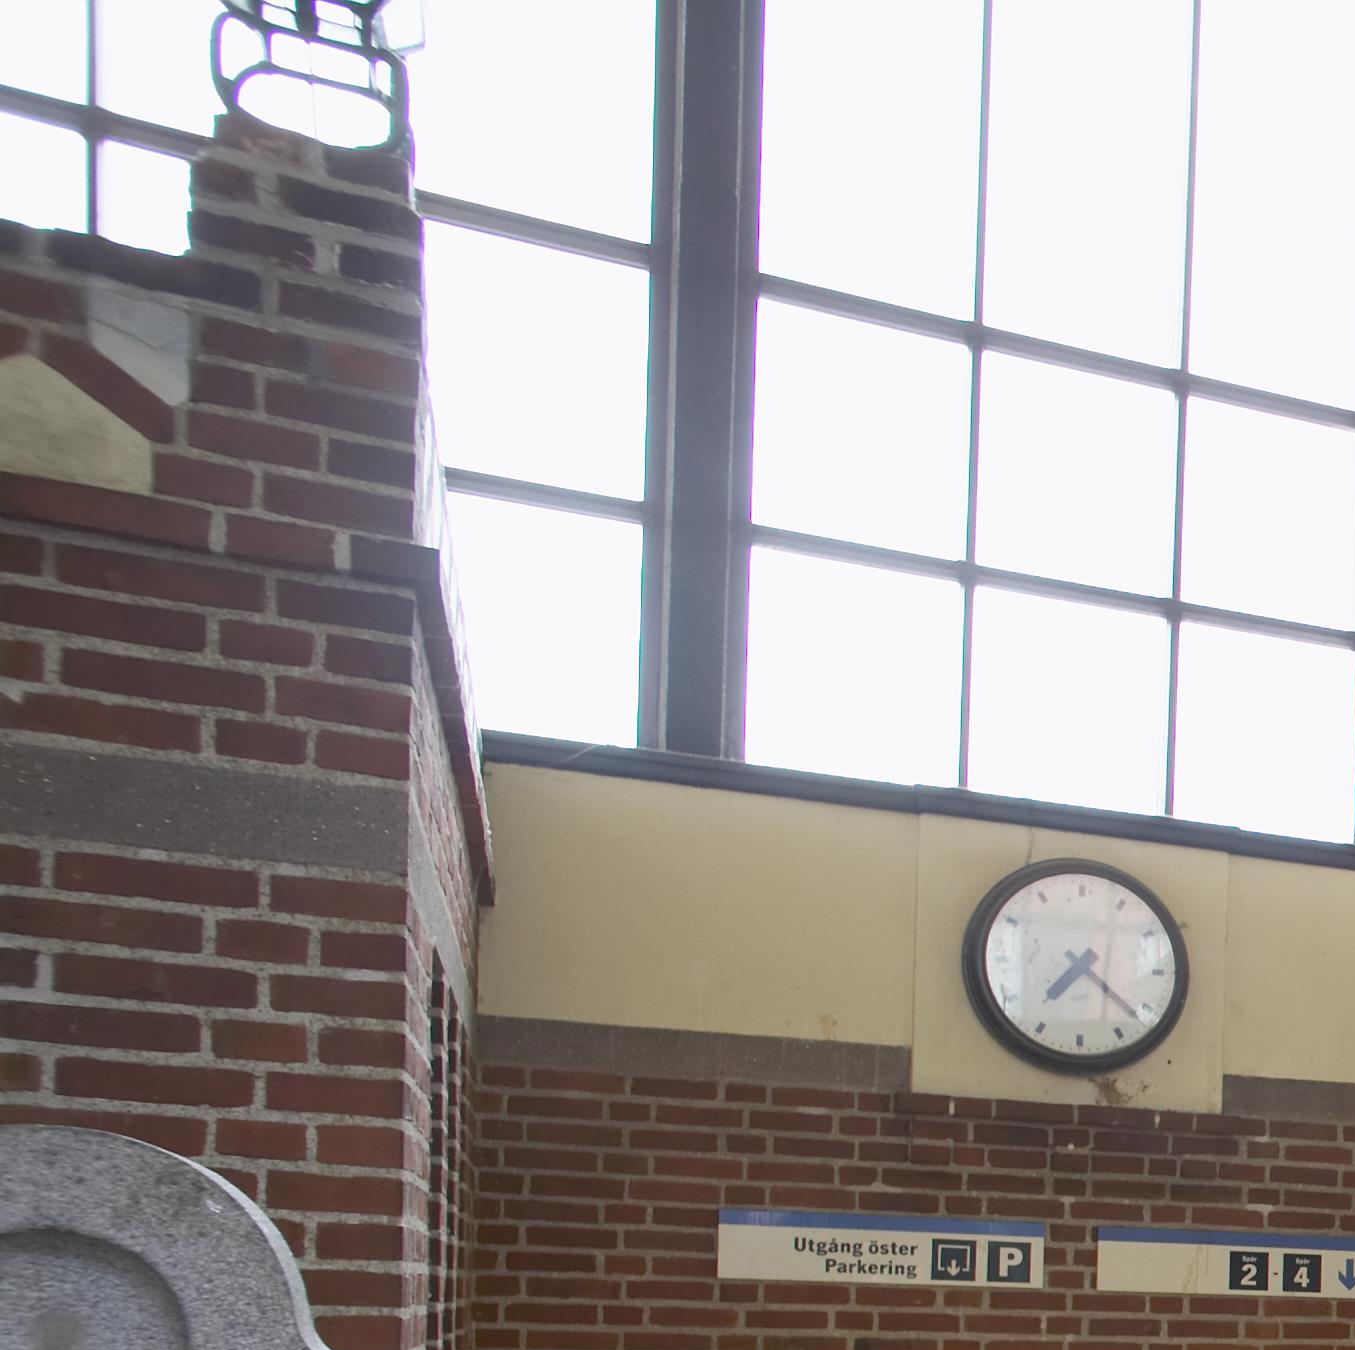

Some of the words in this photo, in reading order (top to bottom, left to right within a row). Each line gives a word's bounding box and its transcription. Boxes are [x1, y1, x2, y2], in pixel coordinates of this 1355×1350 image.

[793, 1236, 864, 1256] Utgång
[868, 1240, 919, 1256] öster
[825, 1258, 918, 1279] Parkering
[999, 1246, 1024, 1277] P
[1240, 1263, 1258, 1286] 2
[1293, 1266, 1310, 1288] 4
